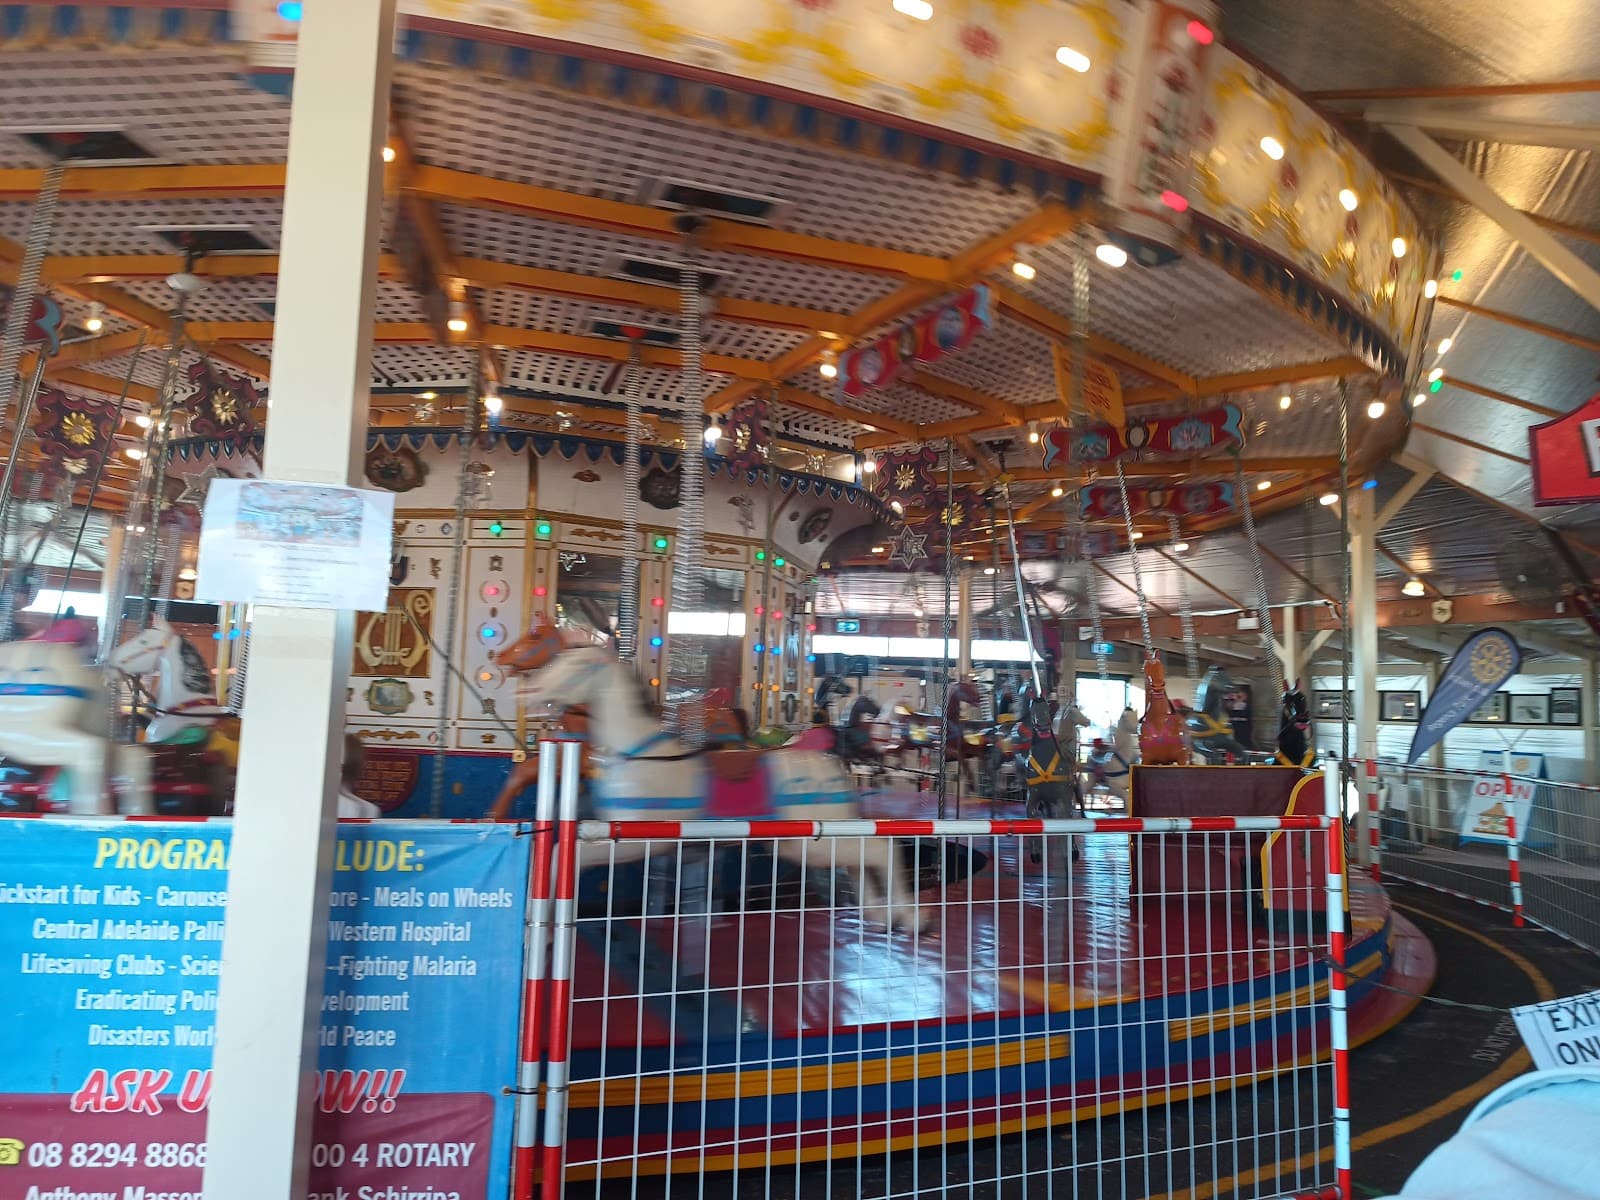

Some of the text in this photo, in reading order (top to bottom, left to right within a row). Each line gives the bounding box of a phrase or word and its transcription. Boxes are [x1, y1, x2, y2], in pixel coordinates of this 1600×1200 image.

[94, 838, 425, 872] PROGRA LUDE:
[0, 883, 69, 905] ickstart
[73, 884, 100, 905] for
[104, 885, 141, 906] Kids
[156, 885, 228, 907] Carouse
[329, 891, 358, 907] ore
[374, 887, 425, 908] Meals
[428, 892, 449, 908] on
[453, 887, 513, 908] Wheels
[32, 917, 471, 945] Central Adelaide Palli Western Hospital
[21, 953, 113, 979] Lifesaving
[116, 954, 165, 976] Clubs
[413, 956, 477, 976] Malaria
[75, 988, 409, 1015] Eradicating Poli velopment
[88, 1025, 169, 1046] Disasters
[319, 1025, 338, 1046] ld
[343, 1025, 396, 1046] Peace
[70, 1068, 173, 1115] ASK
[178, 1068, 214, 1113] U
[28, 1142, 476, 1168] 08 8294 8868 00 4 ROTARY
